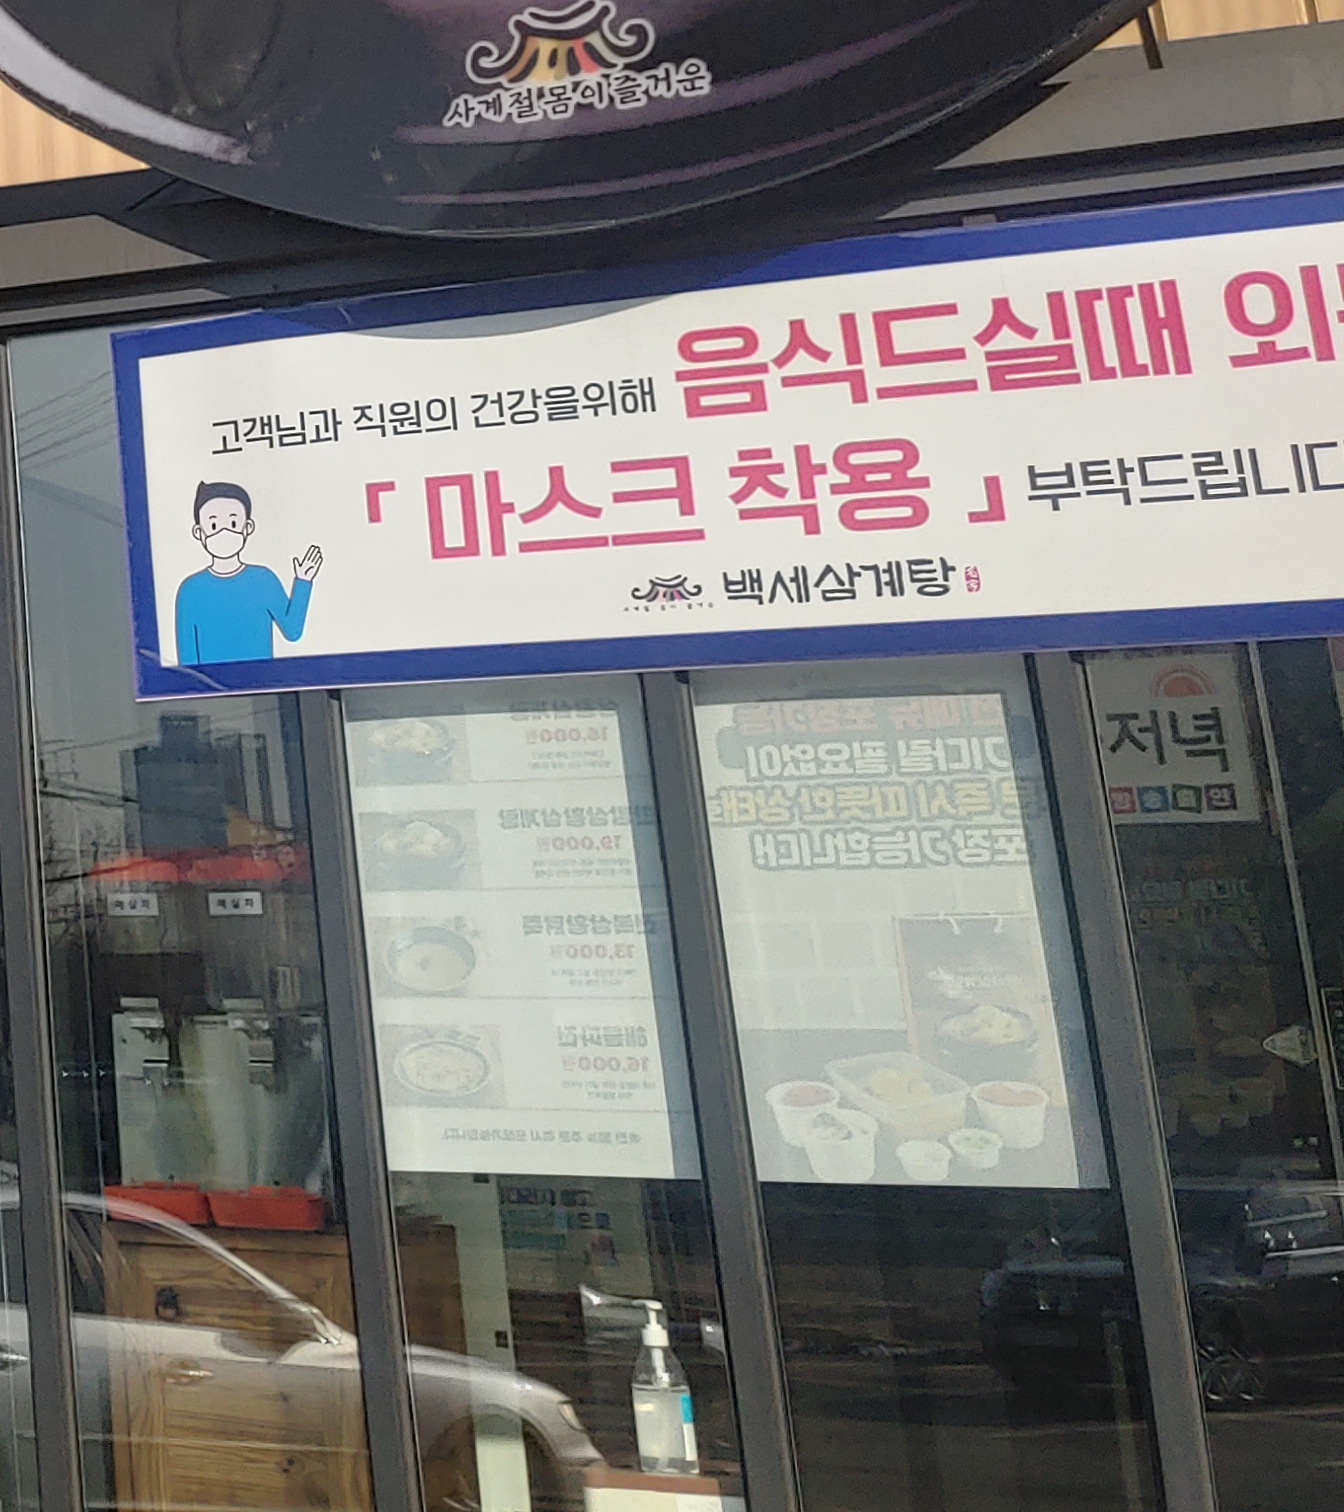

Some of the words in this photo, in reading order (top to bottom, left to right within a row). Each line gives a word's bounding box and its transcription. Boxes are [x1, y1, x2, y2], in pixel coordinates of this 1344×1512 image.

[447, 88, 538, 126] 사계절
[544, 76, 611, 114] 몸이
[614, 60, 708, 106] 즐거운
[211, 407, 343, 456] 고객님과
[352, 396, 458, 440] 직원의
[469, 376, 658, 431] 건강을위해
[674, 278, 1194, 420] 음식드실때
[1223, 263, 1344, 369] 외
[424, 454, 706, 560] 마스크
[727, 437, 932, 536] 착용
[722, 556, 957, 606] 백세삼계탕
[1106, 706, 1230, 773] 저녁
